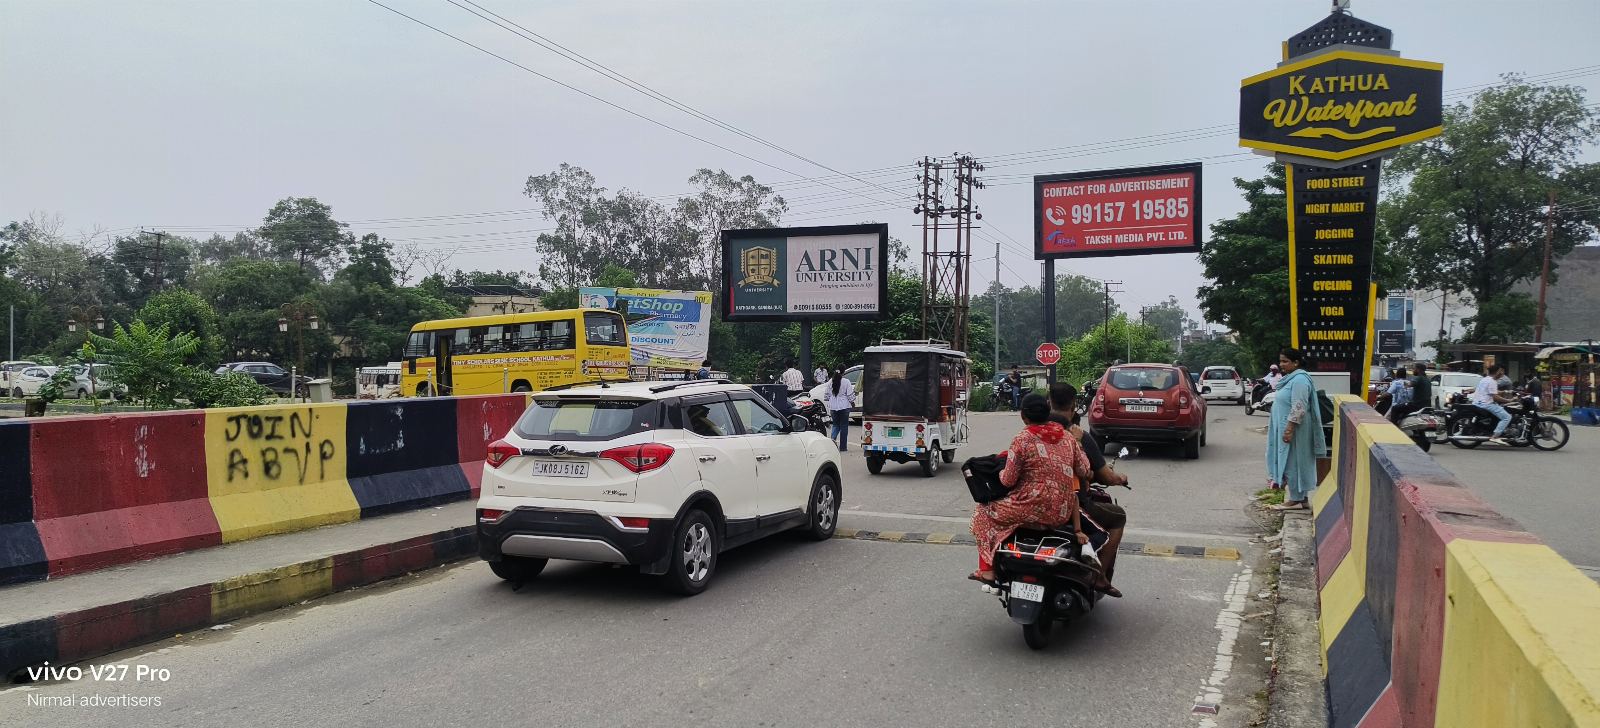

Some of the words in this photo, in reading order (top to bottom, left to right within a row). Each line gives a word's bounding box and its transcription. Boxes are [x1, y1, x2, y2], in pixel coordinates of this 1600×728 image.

[1289, 73, 1390, 95] KATHUA
[1263, 93, 1417, 128] Waterfront
[1043, 185, 1085, 198] CONTACT
[1087, 183, 1106, 195] FOR
[1109, 177, 1190, 193] ADVERTISEMENT
[1306, 178, 1330, 189] FOOD
[1331, 176, 1365, 188] STREET
[1071, 201, 1125, 225] 99157
[1132, 197, 1189, 221] 19585
[1305, 203, 1330, 214] NIGHT
[1331, 202, 1365, 213] MARKET
[1084, 234, 1112, 245] TAKSH
[1115, 233, 1144, 243] MEDIA
[1146, 232, 1166, 242] PVT.
[1168, 230, 1187, 241] LTD.
[1314, 228, 1354, 240] JOGGING
[795, 247, 874, 272] ARNI
[1313, 254, 1354, 265] SKATING
[795, 271, 874, 283] UNIVERSITY
[1312, 280, 1352, 292] CYCLING
[1319, 306, 1344, 316] YOGA
[631, 336, 676, 345] DISCOUNT
[1308, 330, 1355, 341] WALKWAY
[1037, 349, 1059, 358] STOP
[225, 408, 313, 442] JOIN
[227, 439, 335, 485] ABVP
